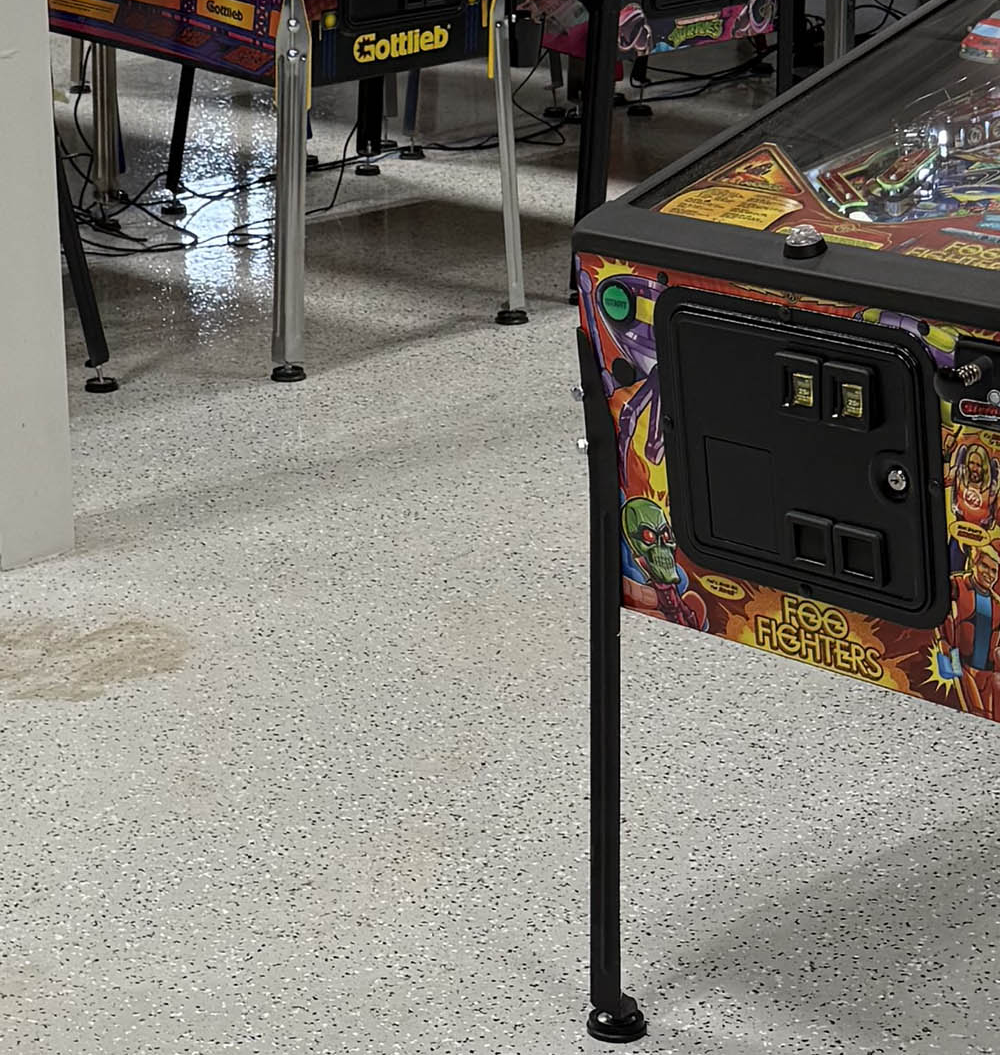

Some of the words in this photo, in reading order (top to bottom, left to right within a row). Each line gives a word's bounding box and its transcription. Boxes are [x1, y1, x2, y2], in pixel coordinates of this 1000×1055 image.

[206, 0, 244, 22] Gottlieb
[353, 25, 449, 63] Gottlieb
[782, 595, 849, 639] FOO
[755, 615, 884, 680] FIGHTERS
